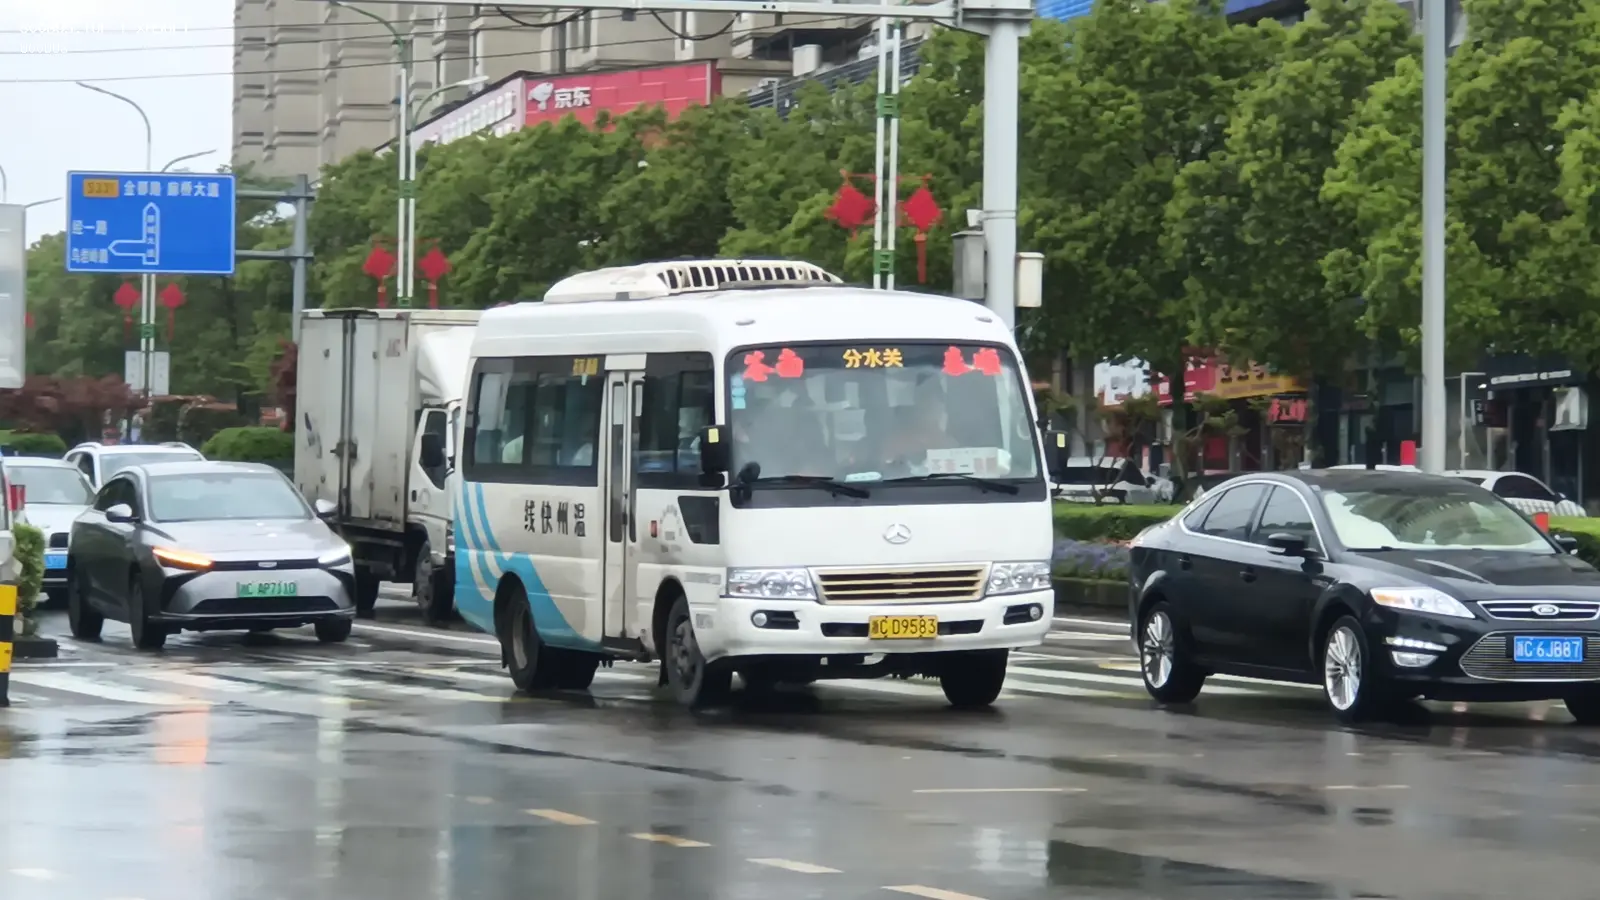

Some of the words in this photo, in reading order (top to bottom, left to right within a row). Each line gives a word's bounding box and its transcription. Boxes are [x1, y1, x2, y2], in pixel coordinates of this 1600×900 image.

[554, 86, 592, 109] 京东
[843, 347, 904, 369] 分水关
